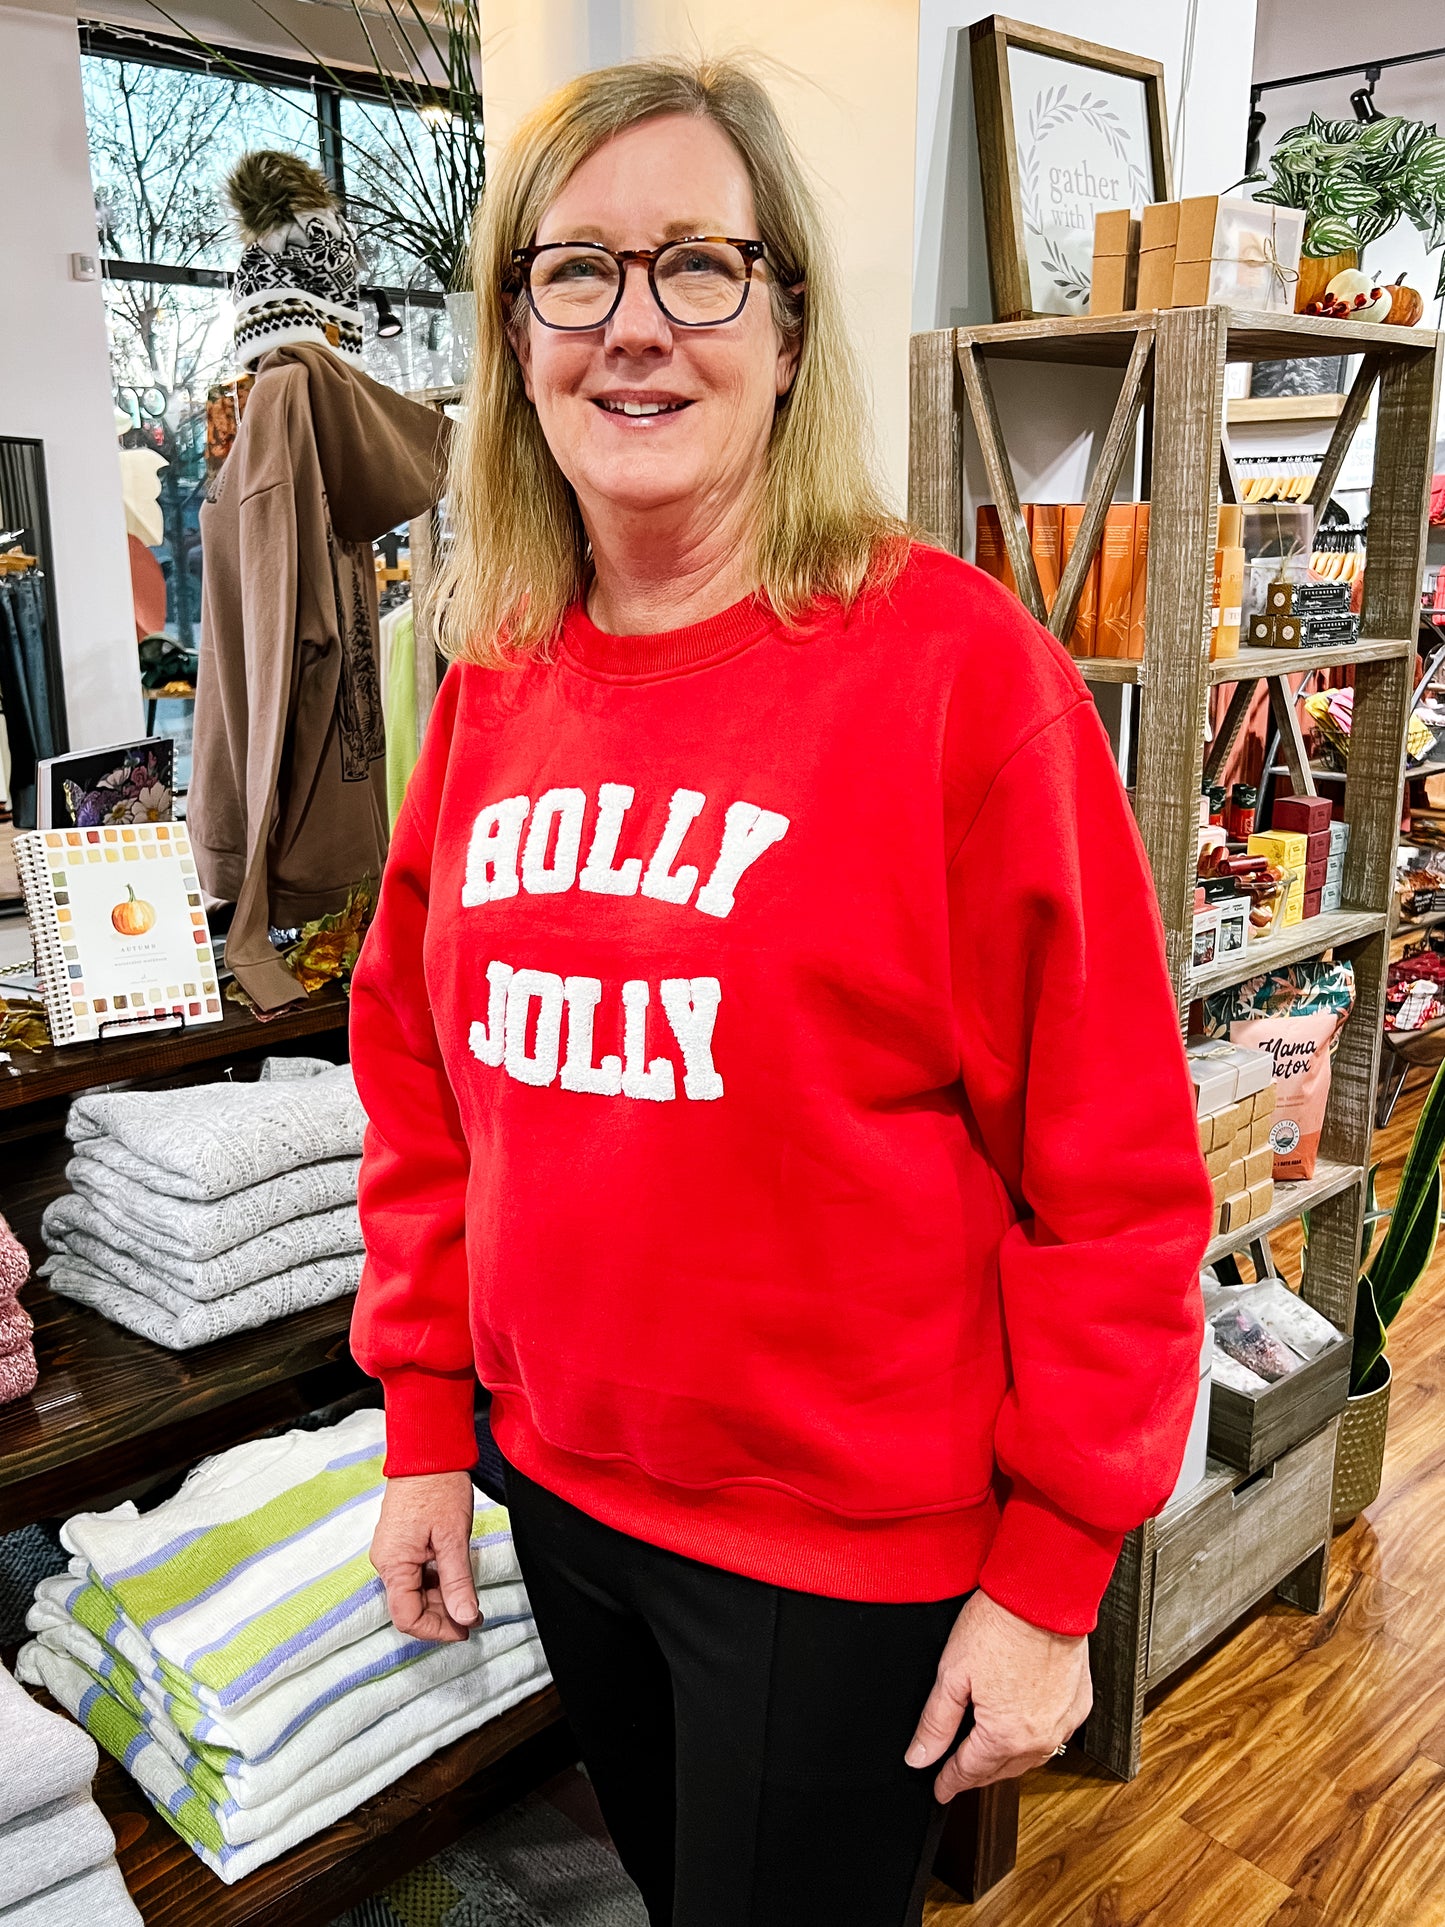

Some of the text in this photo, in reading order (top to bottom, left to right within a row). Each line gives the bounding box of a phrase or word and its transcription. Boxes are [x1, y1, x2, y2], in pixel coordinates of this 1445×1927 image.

[1048, 159, 1119, 204] gather
[1051, 203, 1086, 230] with
[461, 782, 790, 918] HOLLY
[121, 943, 156, 952] AUTUMN
[468, 960, 724, 1102] JOLLY
[1258, 1037, 1317, 1061] Mama
